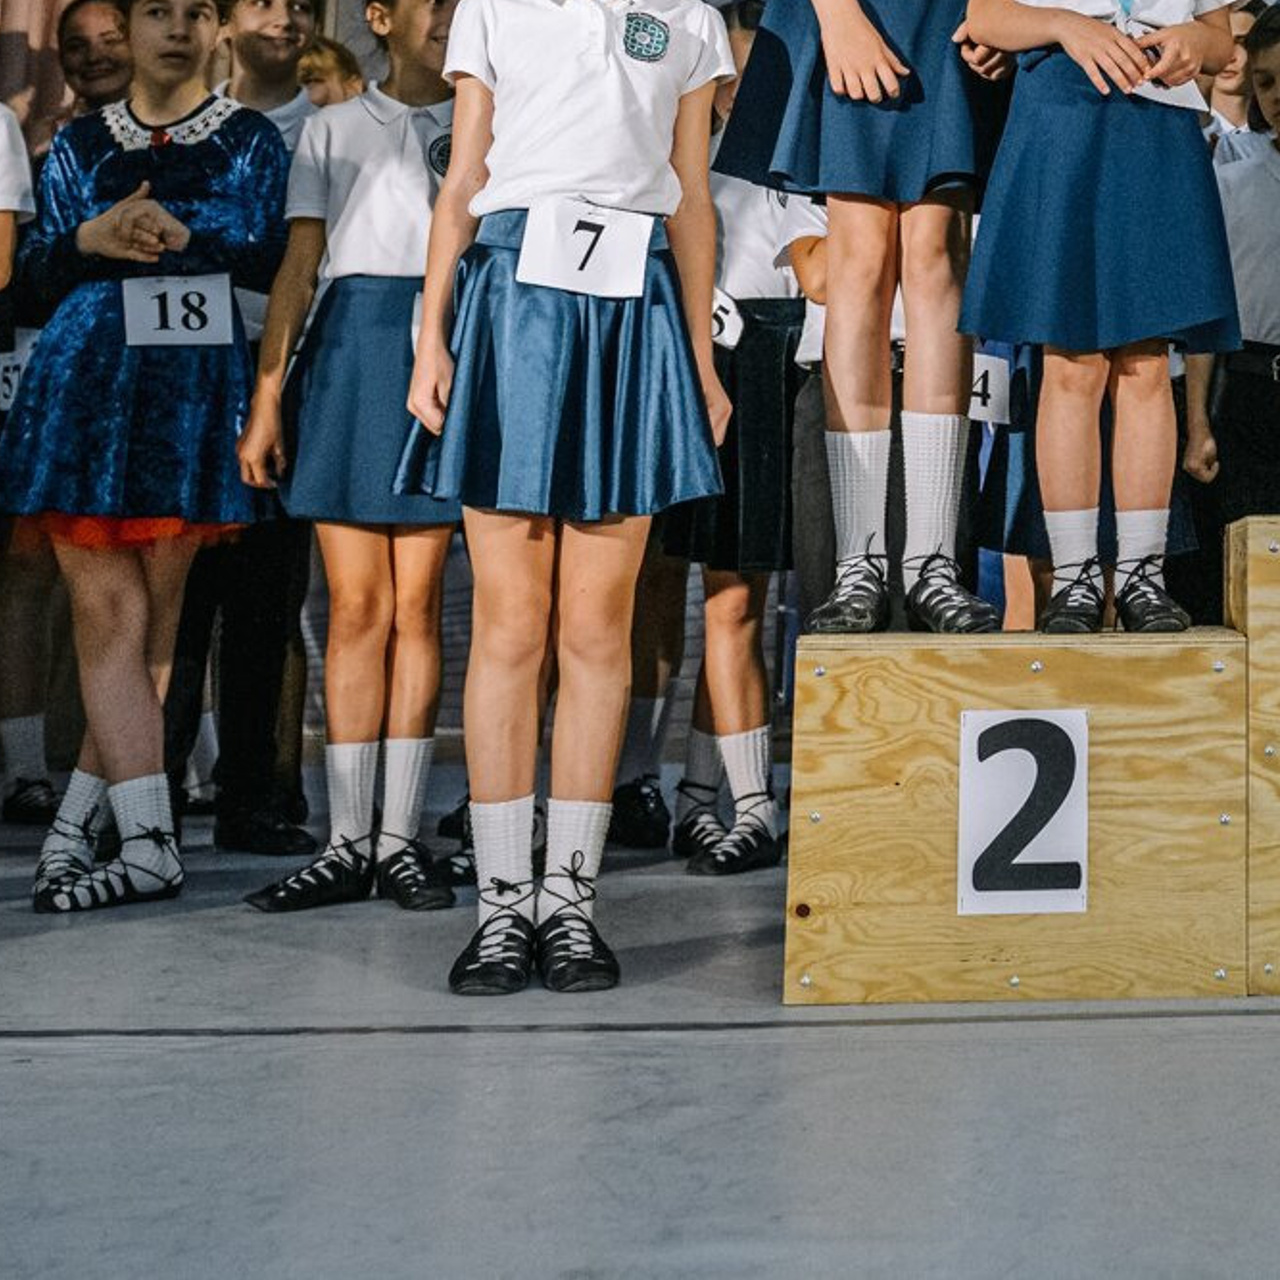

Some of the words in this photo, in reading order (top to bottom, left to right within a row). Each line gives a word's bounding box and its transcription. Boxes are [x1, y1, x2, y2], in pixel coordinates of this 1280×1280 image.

[572, 219, 605, 272] 7
[151, 291, 209, 331] 18
[971, 717, 1083, 892] 2
